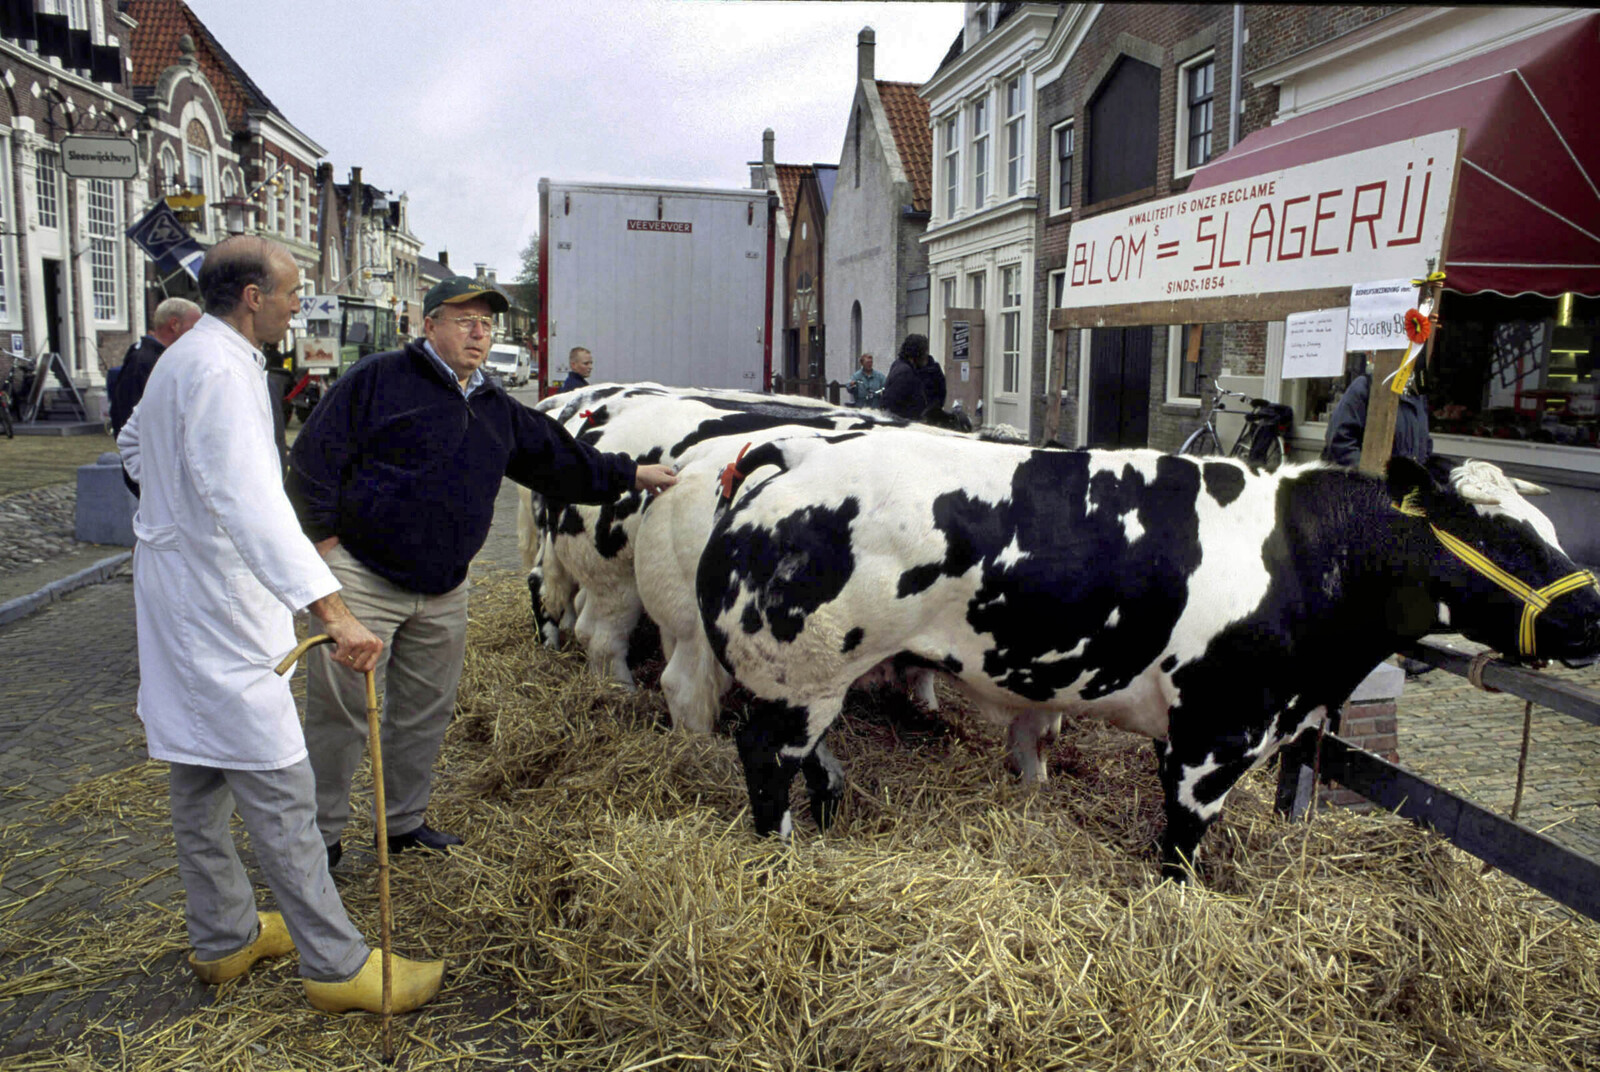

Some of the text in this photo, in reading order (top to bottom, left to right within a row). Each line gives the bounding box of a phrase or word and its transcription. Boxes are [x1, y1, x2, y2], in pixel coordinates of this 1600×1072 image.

[68, 150, 131, 165] Sleeswijckhuys
[1128, 181, 1276, 226] KWALITEIT IS ONZE RECLAME
[629, 221, 690, 232] VEEVERVOER
